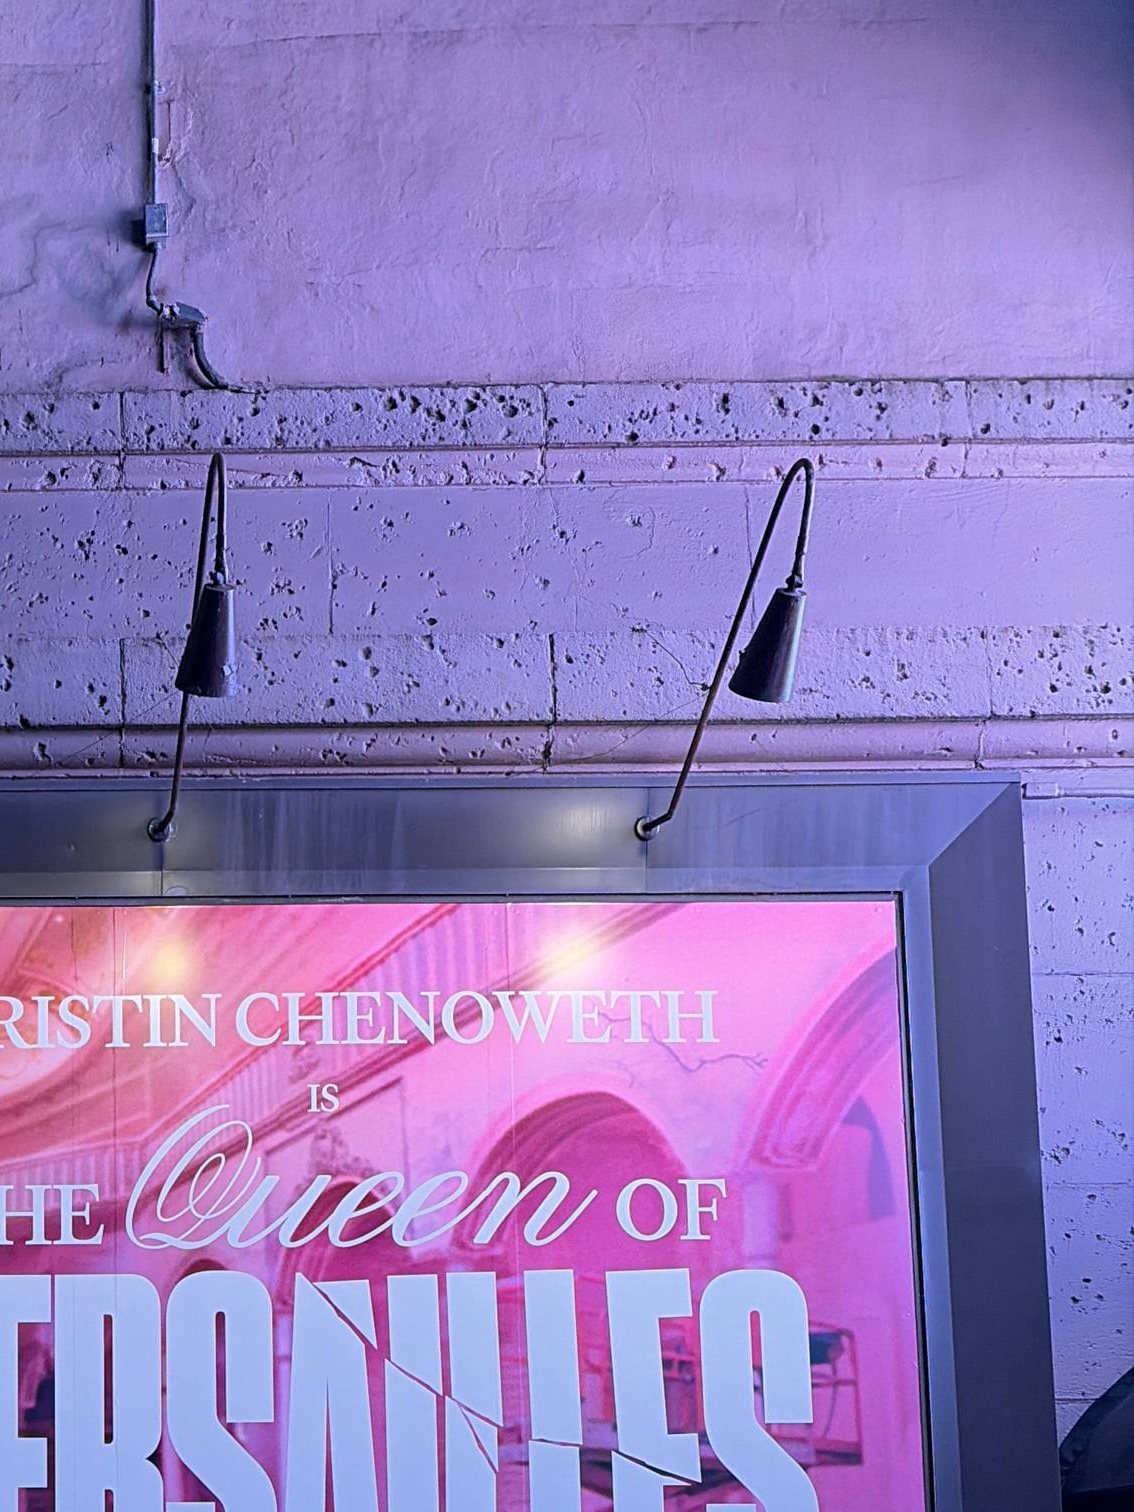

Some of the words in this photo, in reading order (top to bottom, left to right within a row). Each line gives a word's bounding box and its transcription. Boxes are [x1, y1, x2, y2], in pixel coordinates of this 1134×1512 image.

[235, 989, 720, 1046] CHENOWETH
[308, 1083, 339, 1113] IS
[124, 1104, 597, 1250] Queen
[615, 1178, 728, 1242] OF
